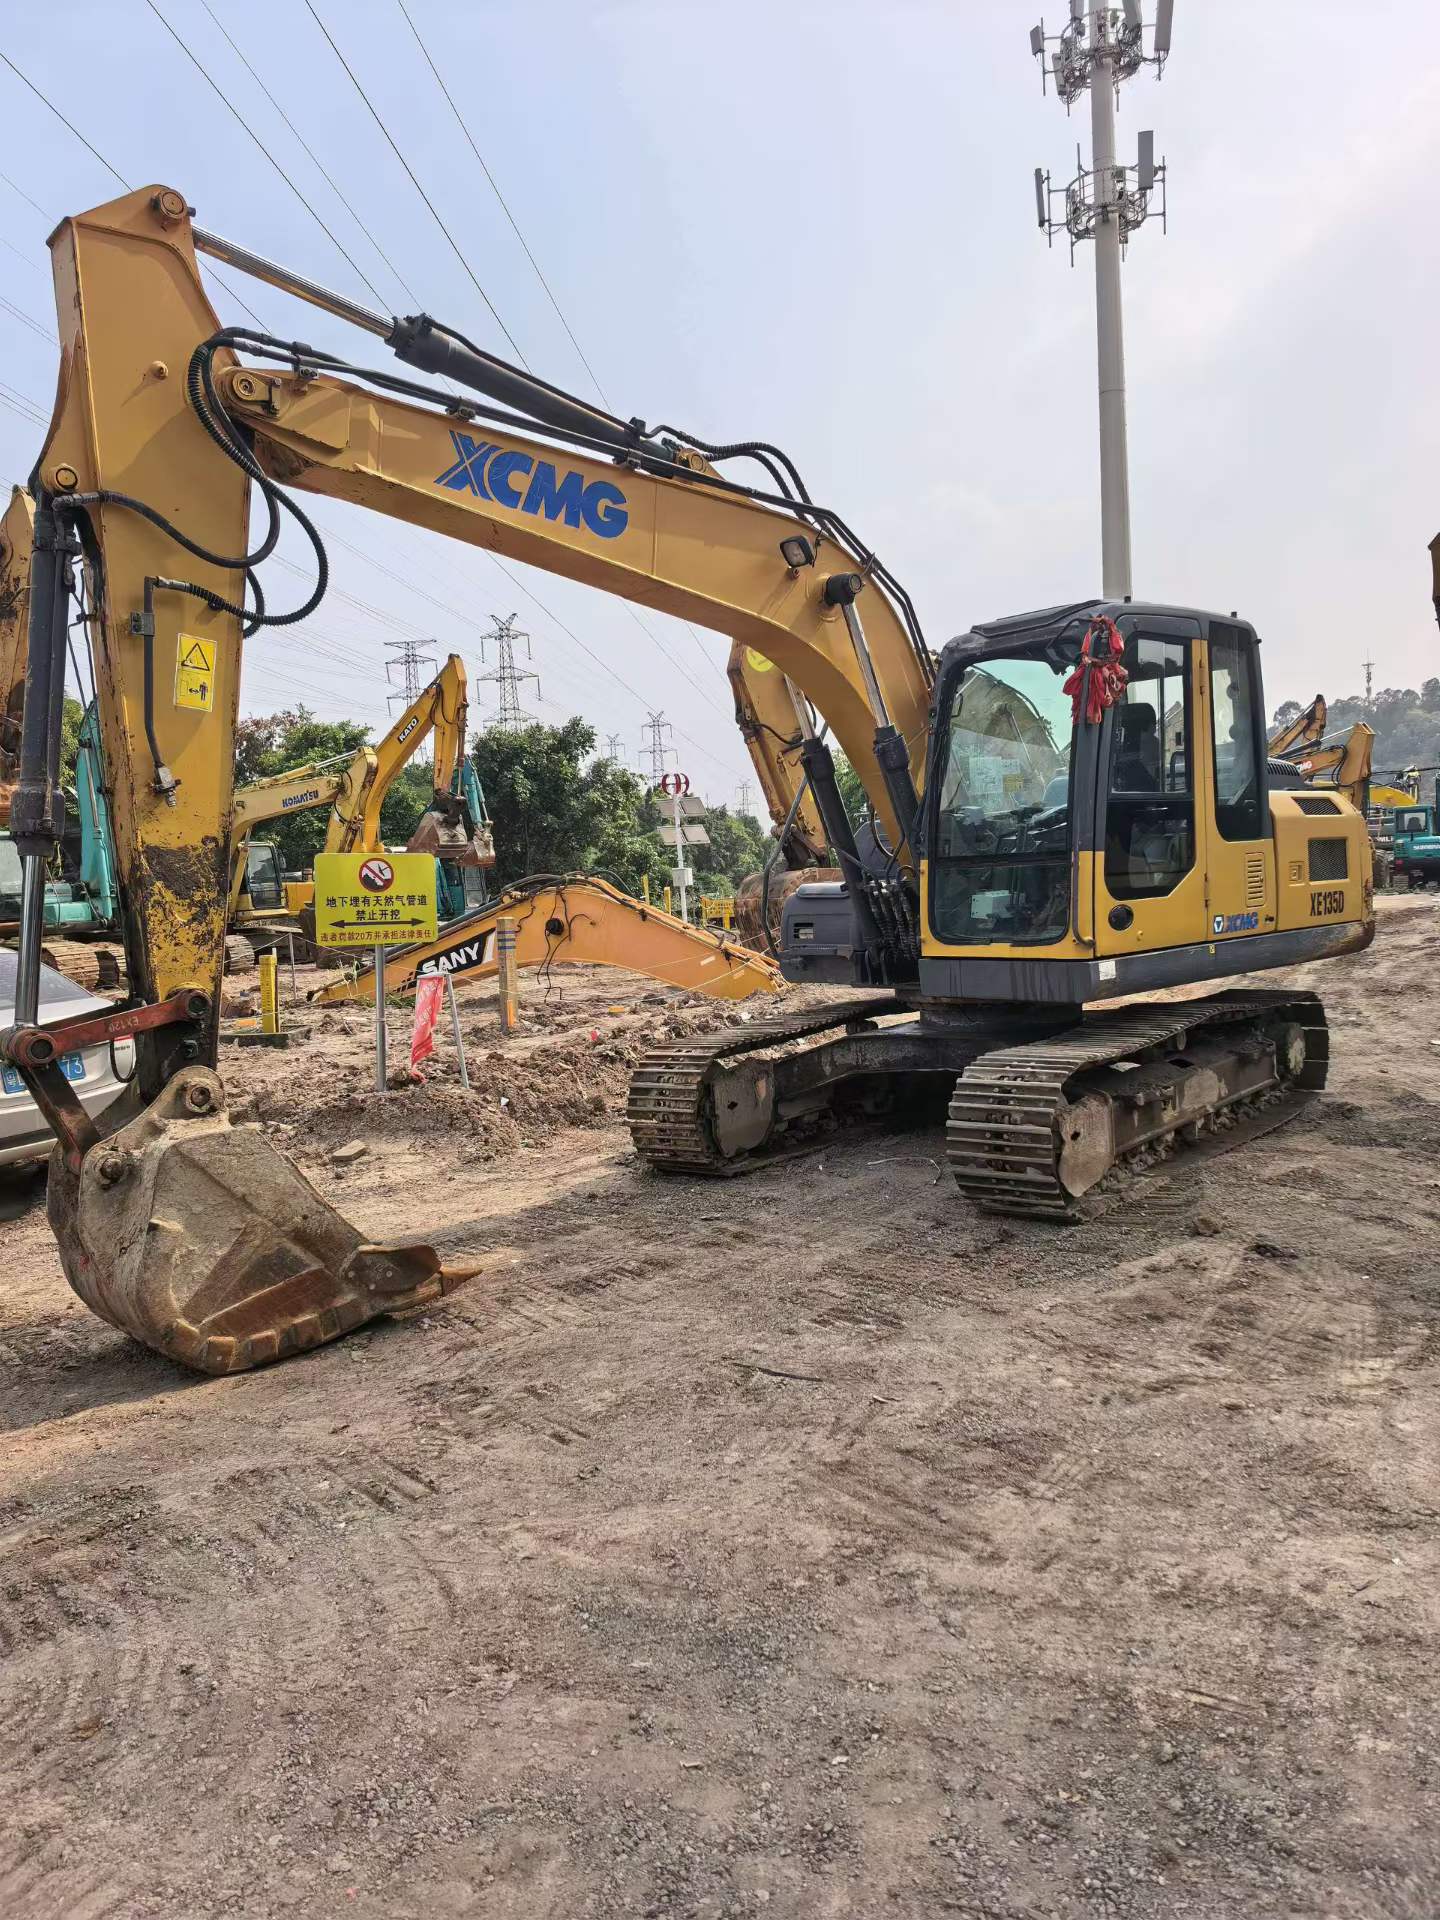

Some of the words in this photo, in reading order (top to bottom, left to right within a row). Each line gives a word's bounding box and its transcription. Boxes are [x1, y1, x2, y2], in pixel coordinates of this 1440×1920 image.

[434, 430, 629, 539] XCMG
[398, 718, 418, 742] KATO
[282, 789, 319, 808] KOMATSU
[326, 894, 428, 908] 地下埋有天然气管道
[1310, 890, 1345, 917] XE135D
[355, 909, 401, 921] 禁止开挖
[422, 941, 480, 975] SANY
